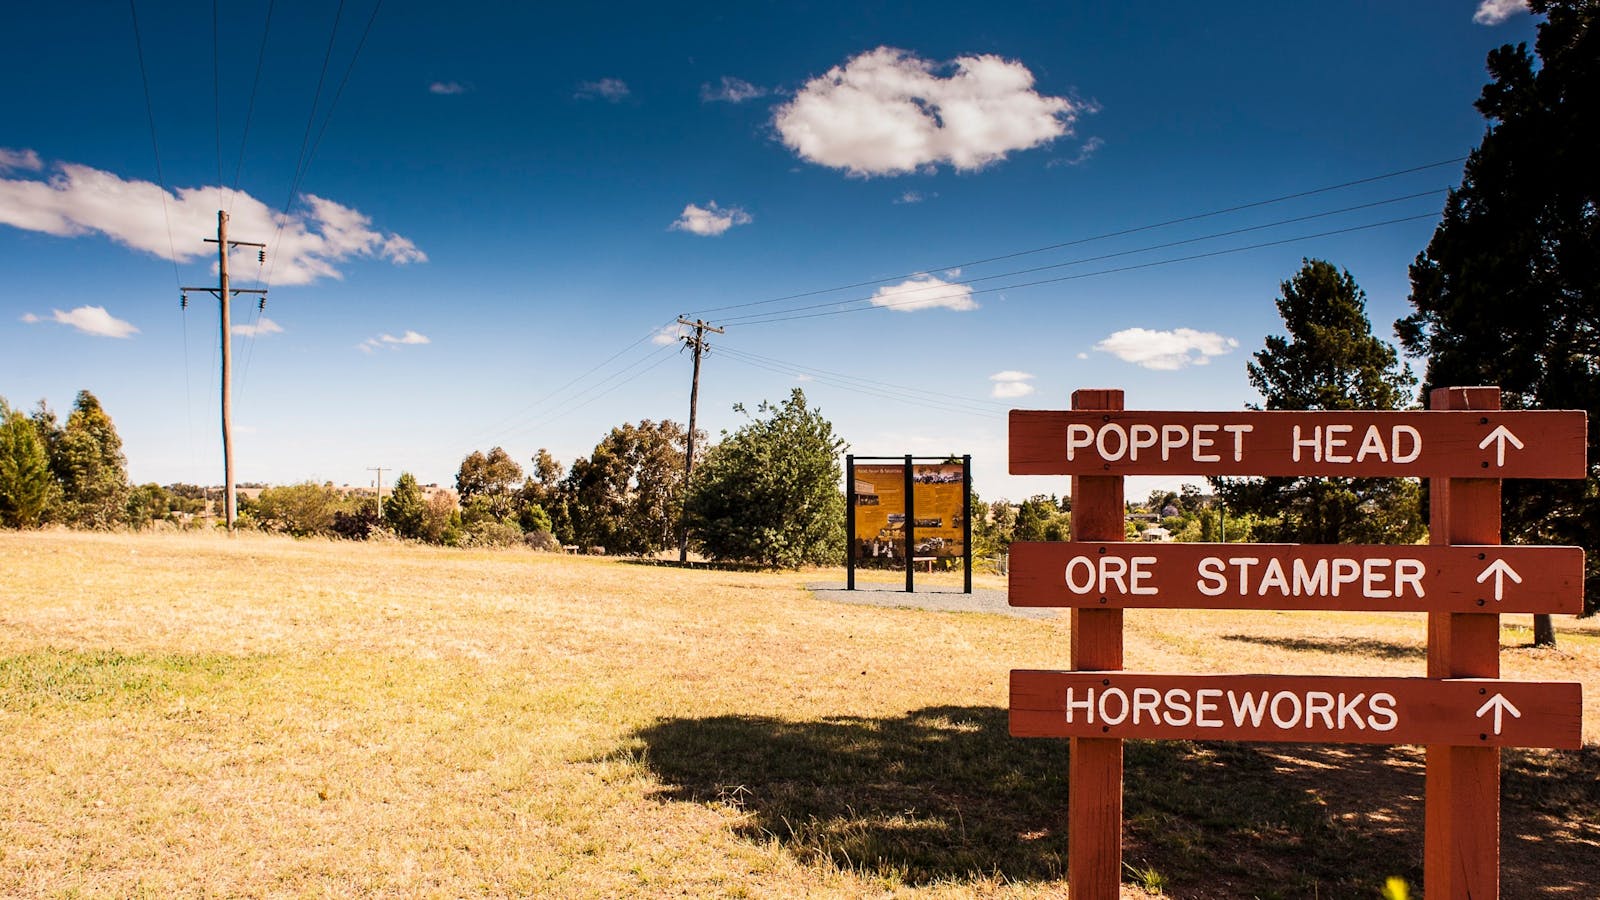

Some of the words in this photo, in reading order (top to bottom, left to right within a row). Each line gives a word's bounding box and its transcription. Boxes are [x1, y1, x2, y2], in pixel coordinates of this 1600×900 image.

[1066, 424, 1254, 462] POPPET
[1292, 425, 1422, 464] HEAD
[1065, 555, 1159, 595] ORE
[1197, 557, 1426, 598] STAMPER
[1066, 687, 1398, 731] HORSEWORKS
